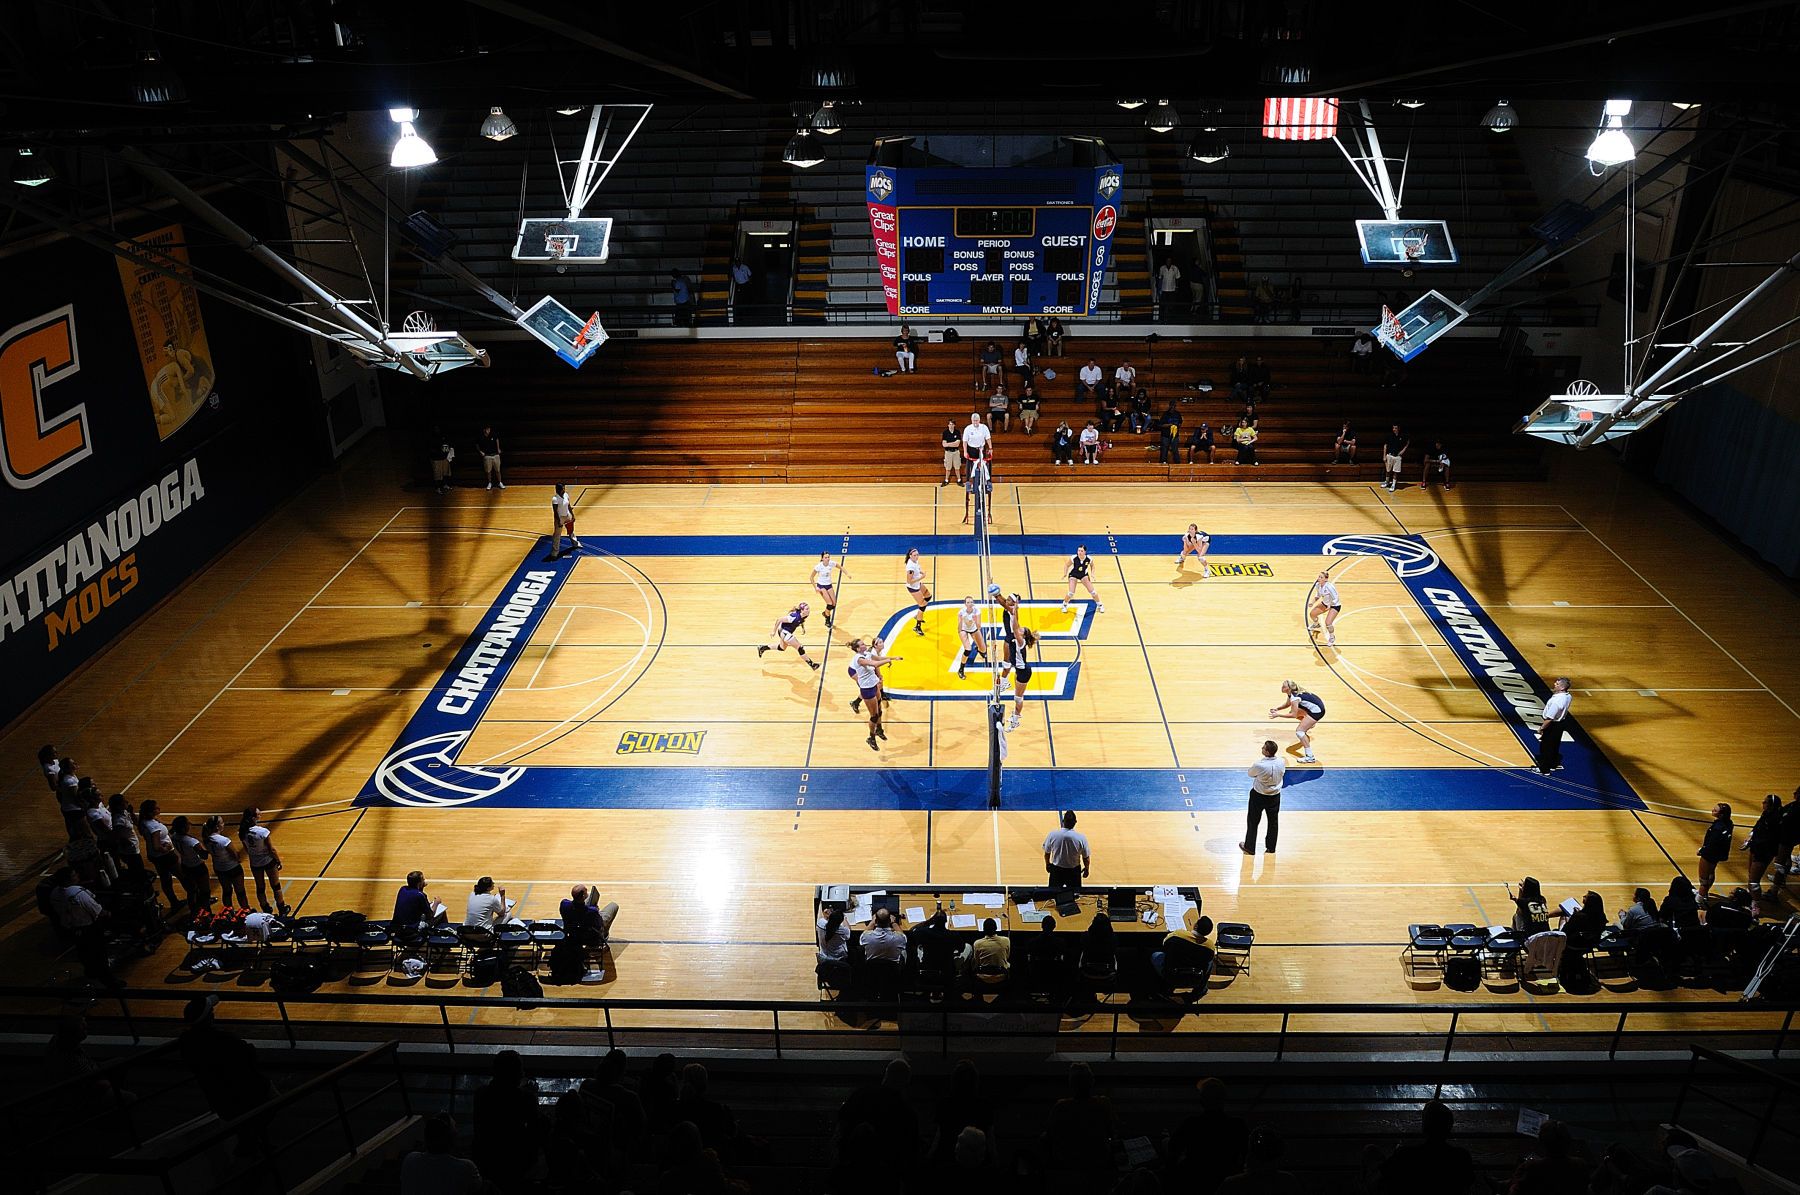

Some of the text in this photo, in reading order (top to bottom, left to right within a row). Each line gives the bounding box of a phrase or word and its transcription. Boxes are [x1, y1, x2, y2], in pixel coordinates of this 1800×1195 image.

[870, 177, 892, 191] MOCS
[1099, 175, 1120, 190] MOCS
[870, 208, 895, 221] Great
[875, 238, 896, 250] Great
[903, 236, 945, 247] HOME
[978, 239, 1011, 248] PERIOD
[1042, 235, 1087, 247] GUEST
[953, 250, 985, 259] BONUS
[1004, 250, 1035, 259] BONUS
[880, 264, 896, 273] Great
[953, 262, 978, 271] POSS
[1009, 262, 1034, 271] POSS
[902, 273, 932, 282] FOULS
[970, 273, 1032, 282] PLAYER FOUL
[1056, 273, 1085, 281] FOULS
[1089, 245, 1105, 309] GO MOCS
[884, 285, 898, 293] Great
[899, 306, 930, 314] SCORE
[982, 306, 1012, 314] MATCH
[1043, 305, 1073, 314] SCORE
[45, 553, 138, 652] MOCS
[437, 571, 556, 715] CHATTANOOGA
